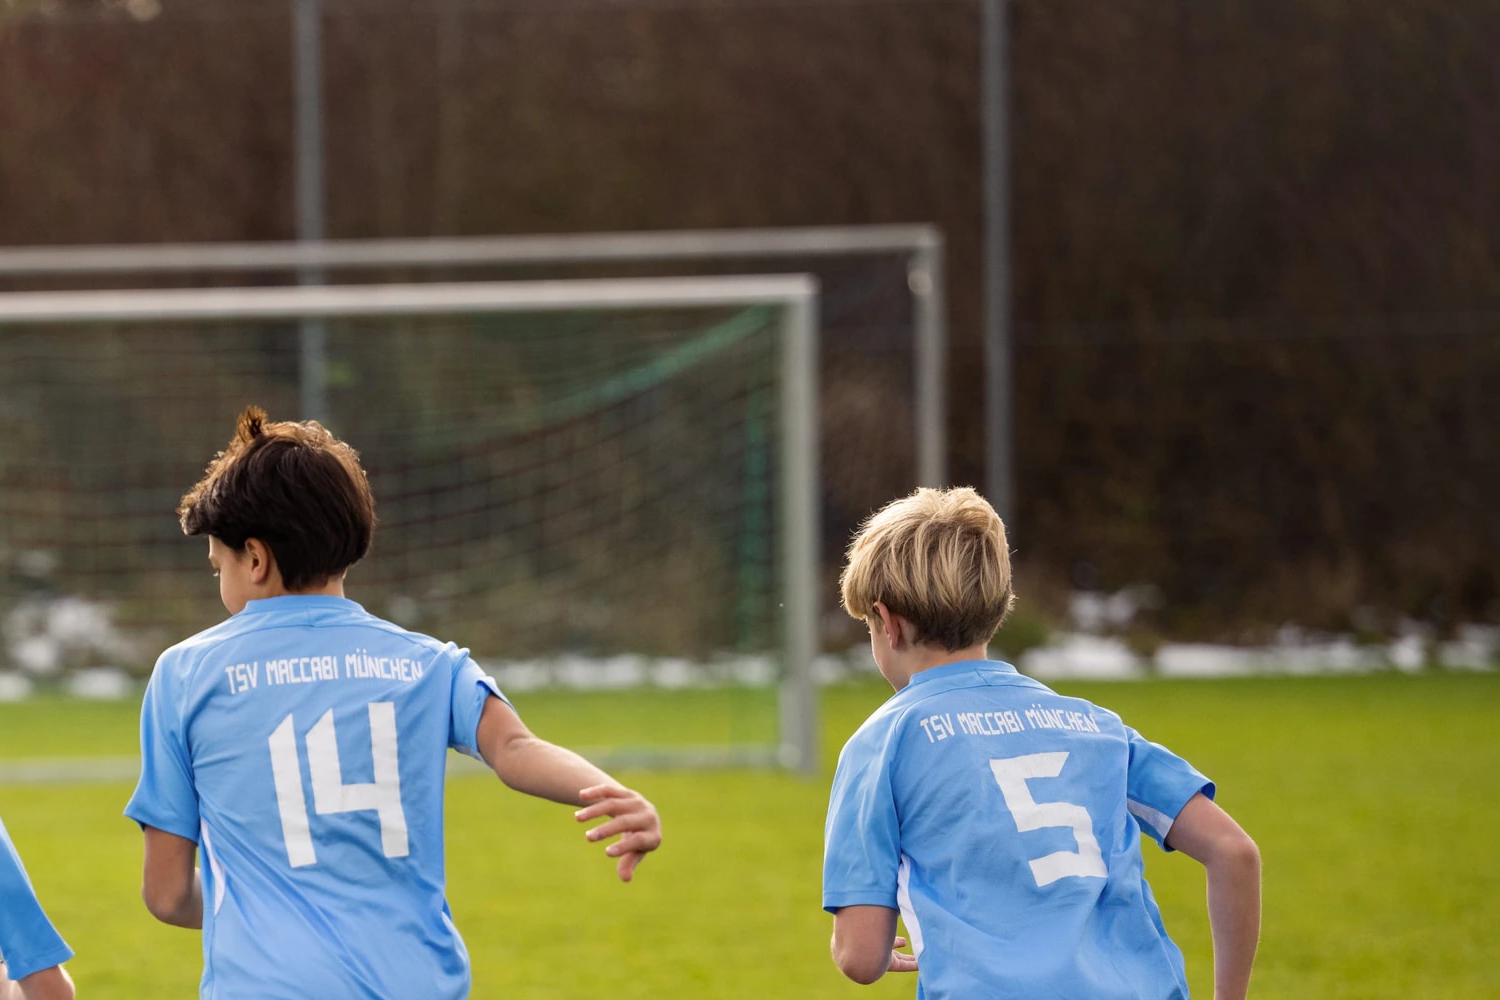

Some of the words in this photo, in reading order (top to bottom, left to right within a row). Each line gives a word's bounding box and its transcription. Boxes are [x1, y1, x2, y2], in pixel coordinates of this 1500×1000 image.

[225, 661, 258, 694] TSV
[265, 655, 339, 686] MACCABI
[345, 648, 423, 682] MÜNCHEN
[920, 714, 955, 743] TSV
[956, 710, 1025, 736] MACCABI
[1025, 703, 1101, 733] MÜNCHEN
[268, 701, 410, 868] 14
[989, 751, 1109, 887] 5
